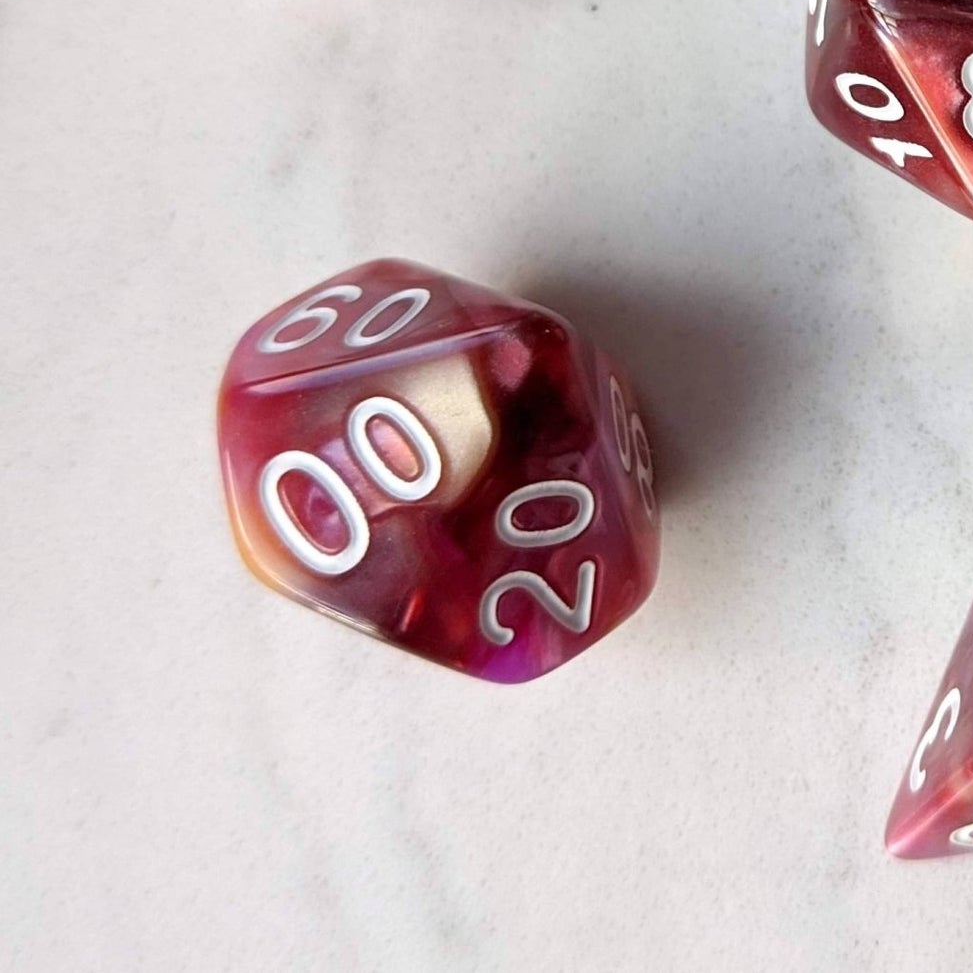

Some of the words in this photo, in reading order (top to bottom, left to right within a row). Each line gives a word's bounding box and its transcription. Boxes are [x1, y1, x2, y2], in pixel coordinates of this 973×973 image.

[256, 284, 431, 354] 60
[260, 396, 443, 576] 00
[479, 480, 596, 646] 20
[909, 687, 961, 793] 3
